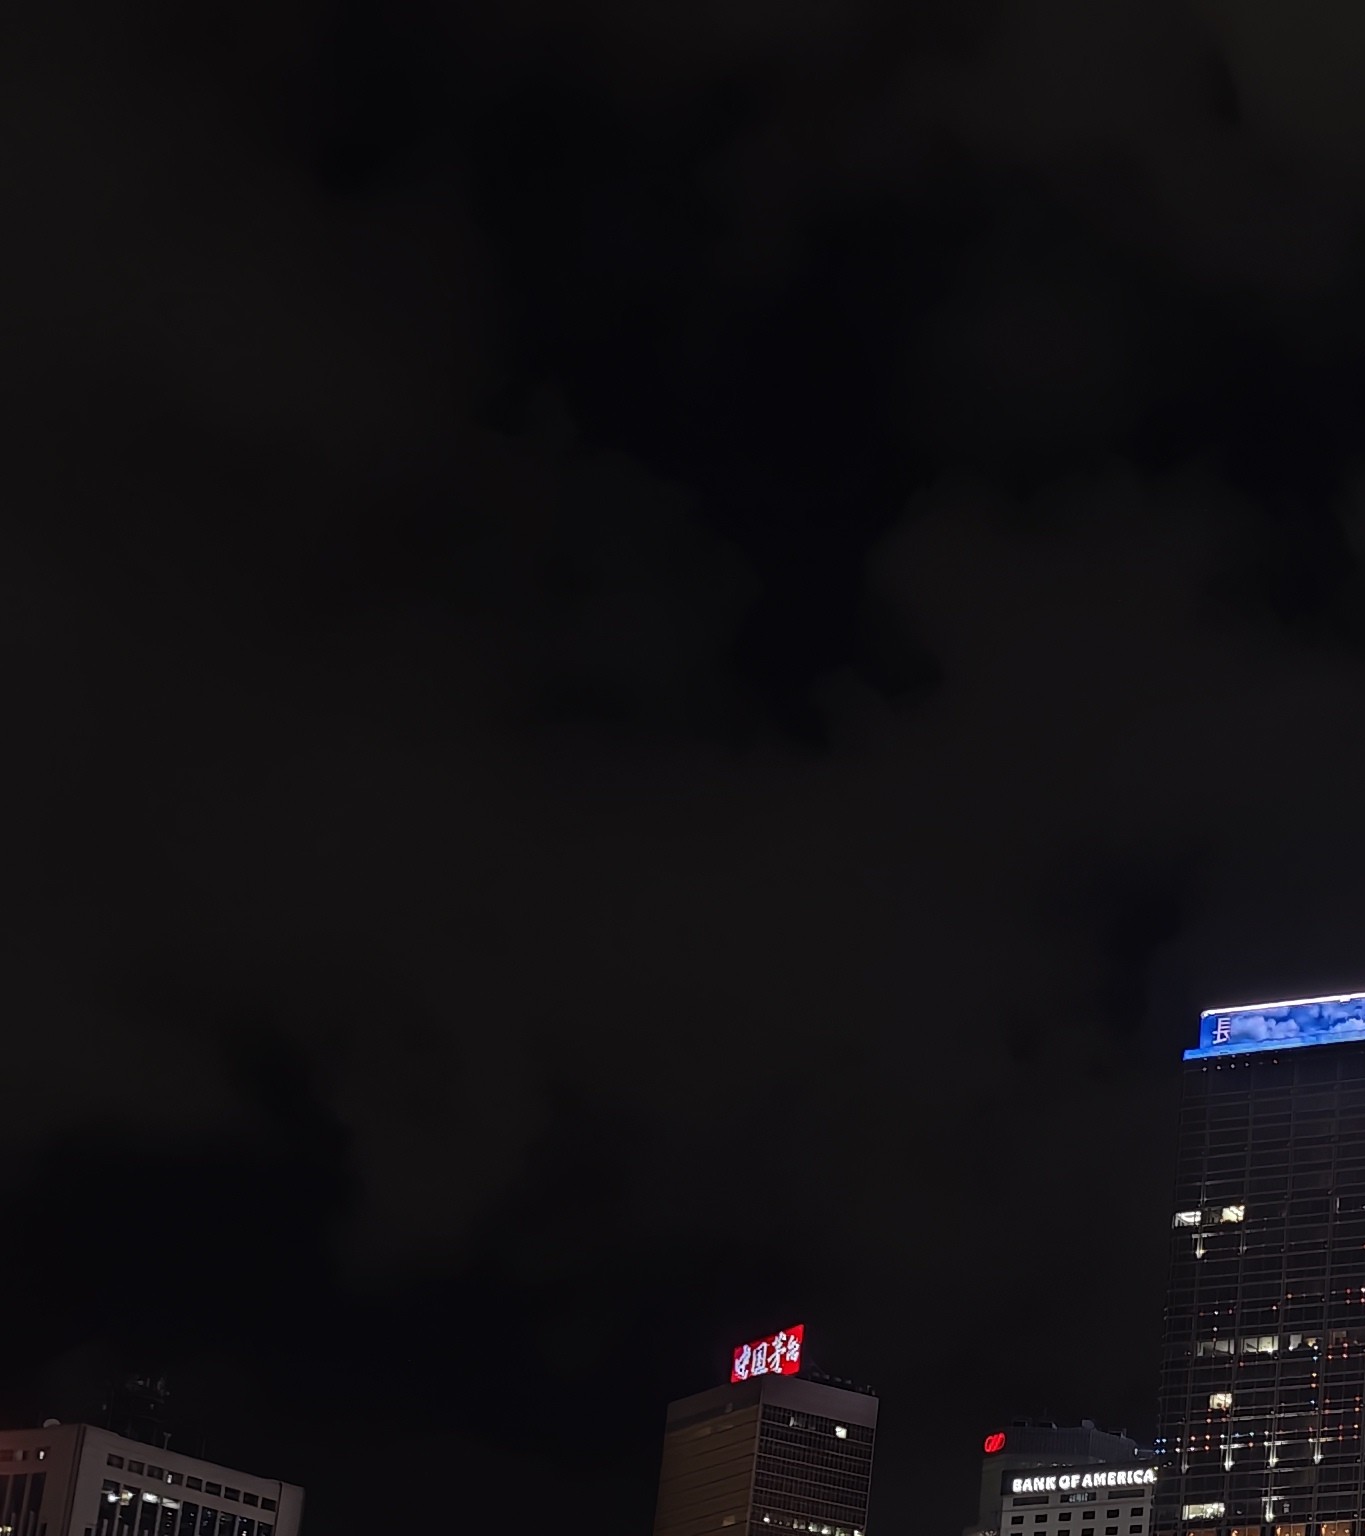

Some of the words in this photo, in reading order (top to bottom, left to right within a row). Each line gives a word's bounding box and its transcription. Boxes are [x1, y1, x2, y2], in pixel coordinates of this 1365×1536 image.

[1012, 1476, 1057, 1493] BANK
[1059, 1473, 1082, 1490] OF
[1082, 1467, 1155, 1487] AMERICA
